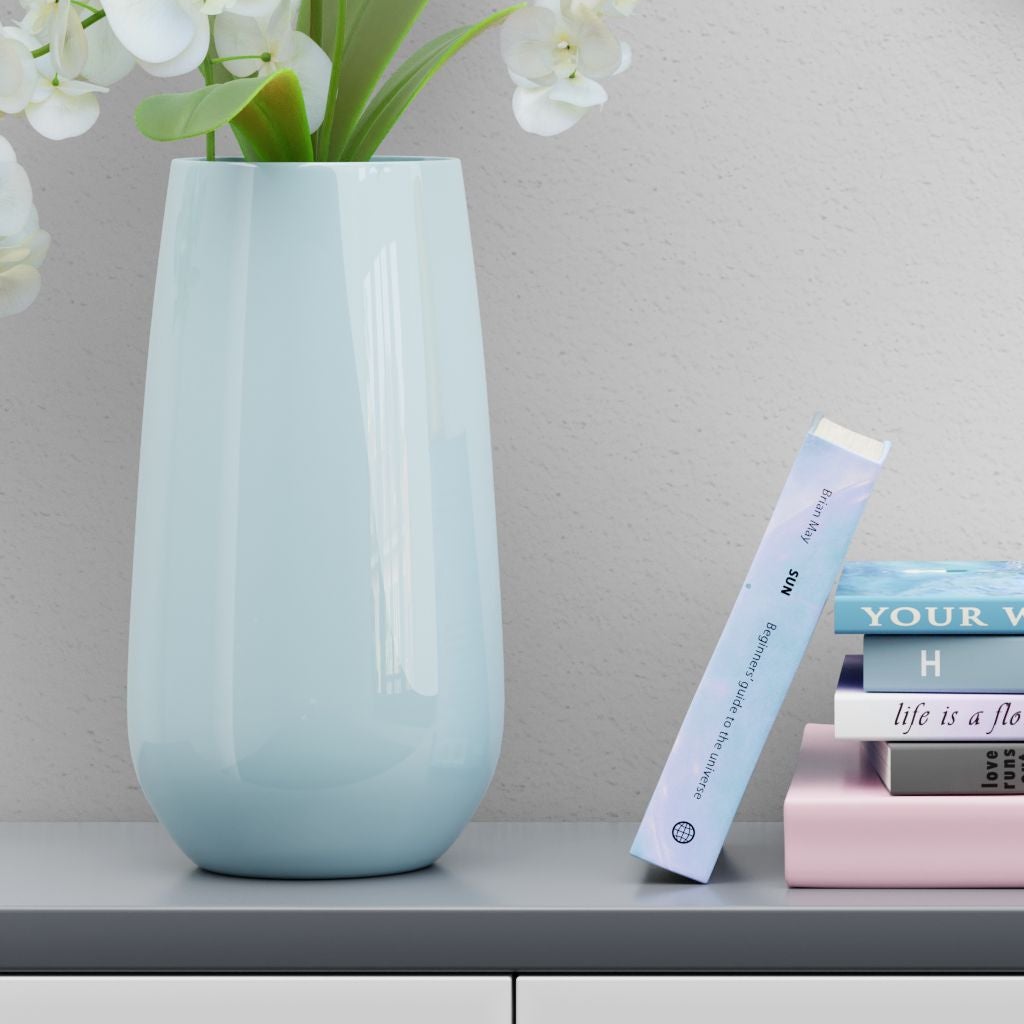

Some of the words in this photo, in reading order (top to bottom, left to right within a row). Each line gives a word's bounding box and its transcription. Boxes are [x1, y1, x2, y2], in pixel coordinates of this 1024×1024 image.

[812, 488, 833, 518] Brian
[800, 519, 820, 544] May
[780, 568, 799, 596] SUN
[860, 606, 989, 627] YOUR
[729, 680, 749, 714] guide
[723, 715, 735, 728] to
[894, 702, 930, 734] life
[941, 706, 958, 726] is
[968, 710, 984, 726] a
[713, 731, 729, 750] the
[693, 752, 719, 800] universe
[981, 750, 999, 788] love
[1003, 748, 1016, 789] runs
